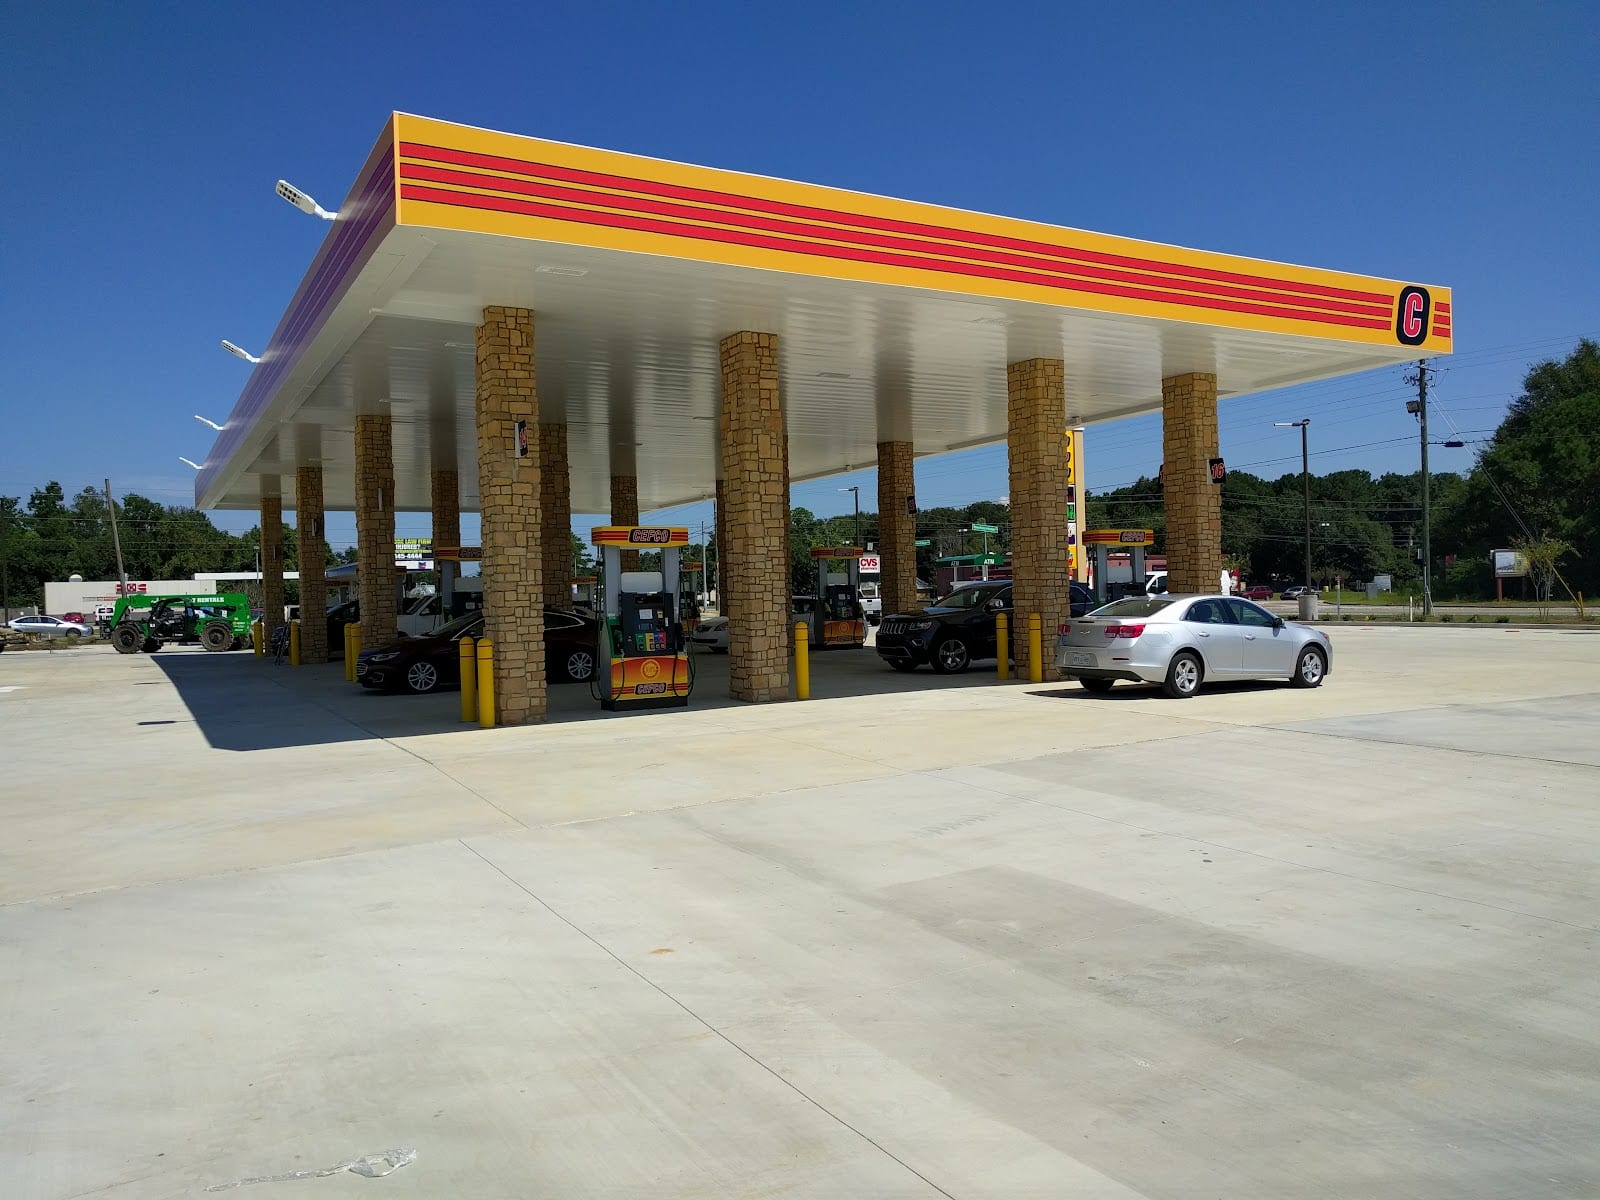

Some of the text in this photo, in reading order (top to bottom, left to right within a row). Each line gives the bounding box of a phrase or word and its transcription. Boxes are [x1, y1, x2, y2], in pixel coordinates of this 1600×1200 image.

[1403, 292, 1423, 338] C
[1212, 463, 1224, 479] 16
[632, 529, 669, 542] CEFCO
[860, 558, 878, 567] CVS
